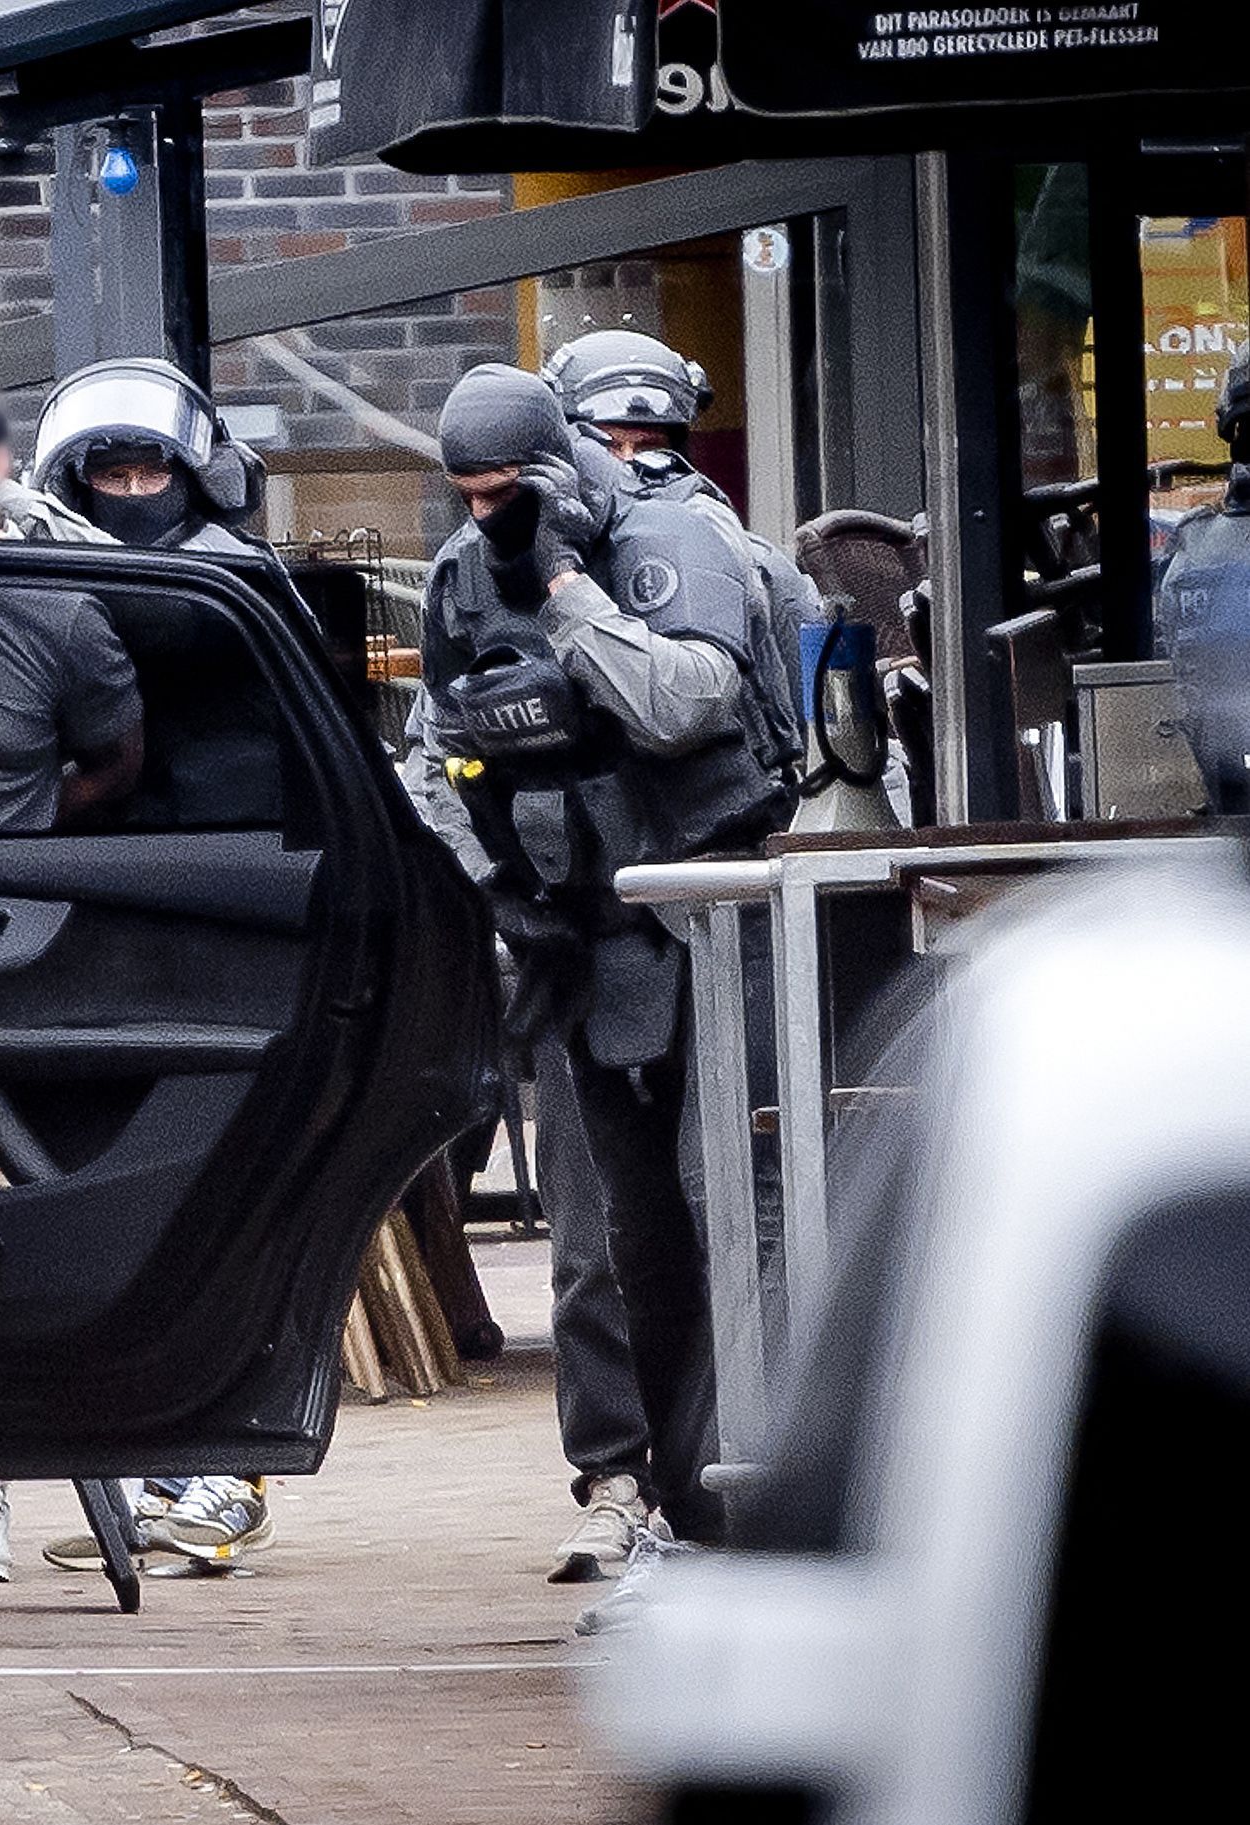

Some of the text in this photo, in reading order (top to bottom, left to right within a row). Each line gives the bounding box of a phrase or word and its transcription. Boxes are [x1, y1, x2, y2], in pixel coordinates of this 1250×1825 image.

[875, 13, 902, 35] DIT
[907, 7, 1030, 31] PARASOLDOEK
[858, 39, 894, 59] VAN
[933, 31, 1049, 55] GERECYCLEDE
